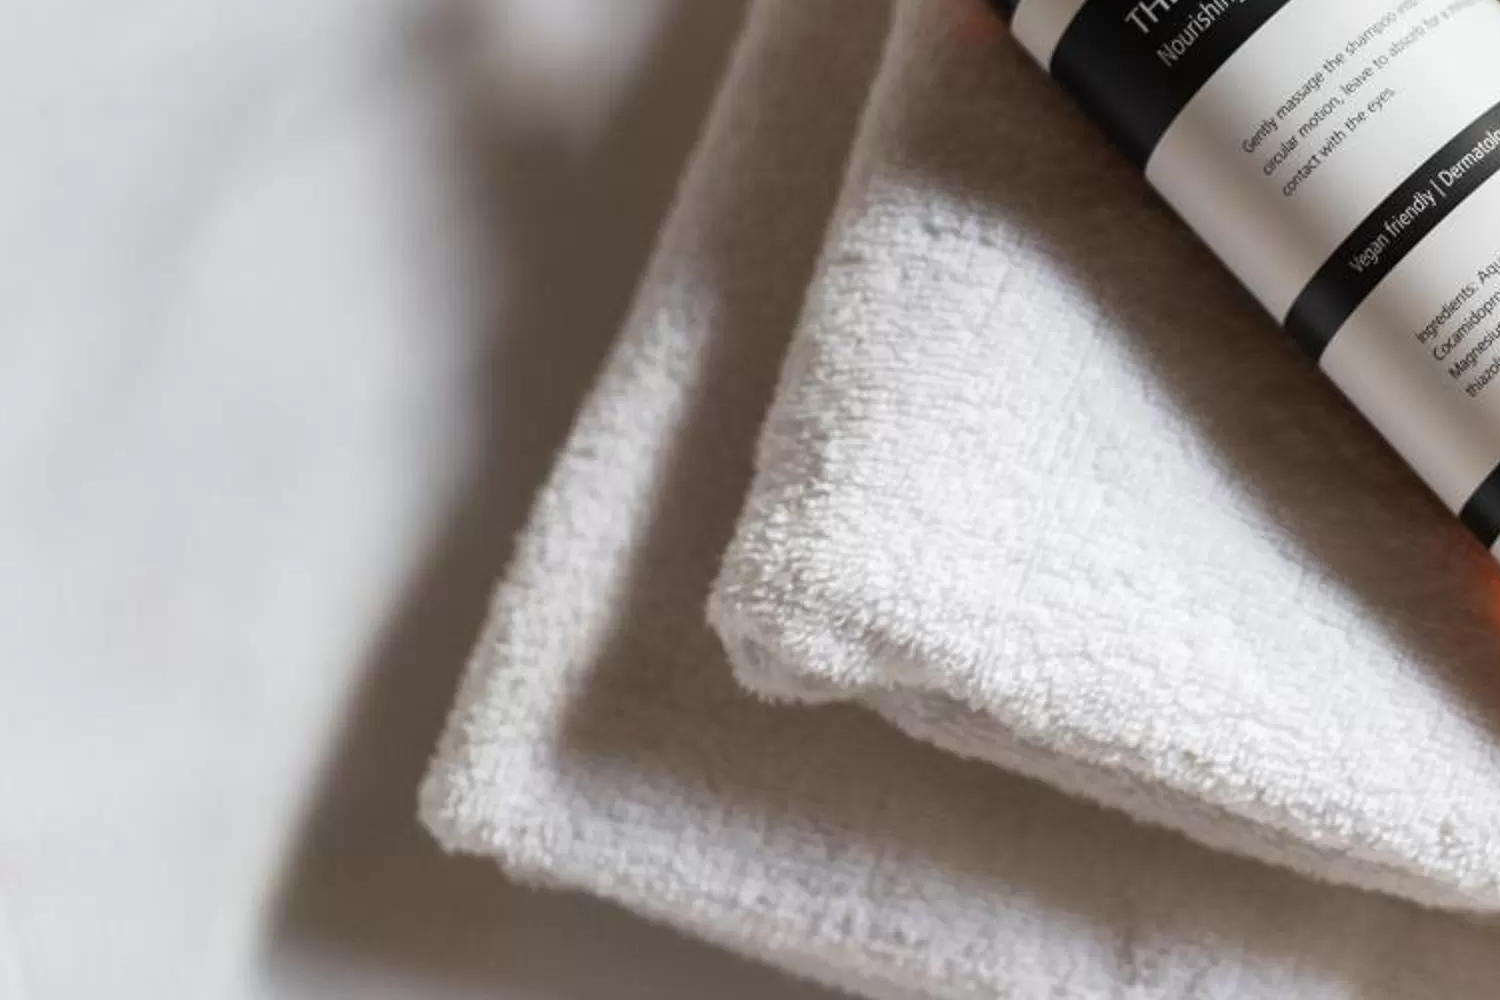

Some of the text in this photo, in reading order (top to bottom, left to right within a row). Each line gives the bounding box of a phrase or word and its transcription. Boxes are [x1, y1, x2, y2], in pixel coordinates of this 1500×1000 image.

[1242, 115, 1277, 155] Gently
[1275, 70, 1325, 121] massage
[1322, 52, 1347, 74] the
[1344, 11, 1397, 56] shampoo
[1261, 136, 1300, 177] circular
[1297, 95, 1345, 137] motion,
[1339, 67, 1375, 97] leave
[1371, 53, 1390, 69] to
[1282, 153, 1321, 197] contact
[1319, 126, 1347, 156] with
[1343, 111, 1367, 131] the
[1348, 233, 1390, 272] Vegan
[1382, 190, 1436, 238] friendly
